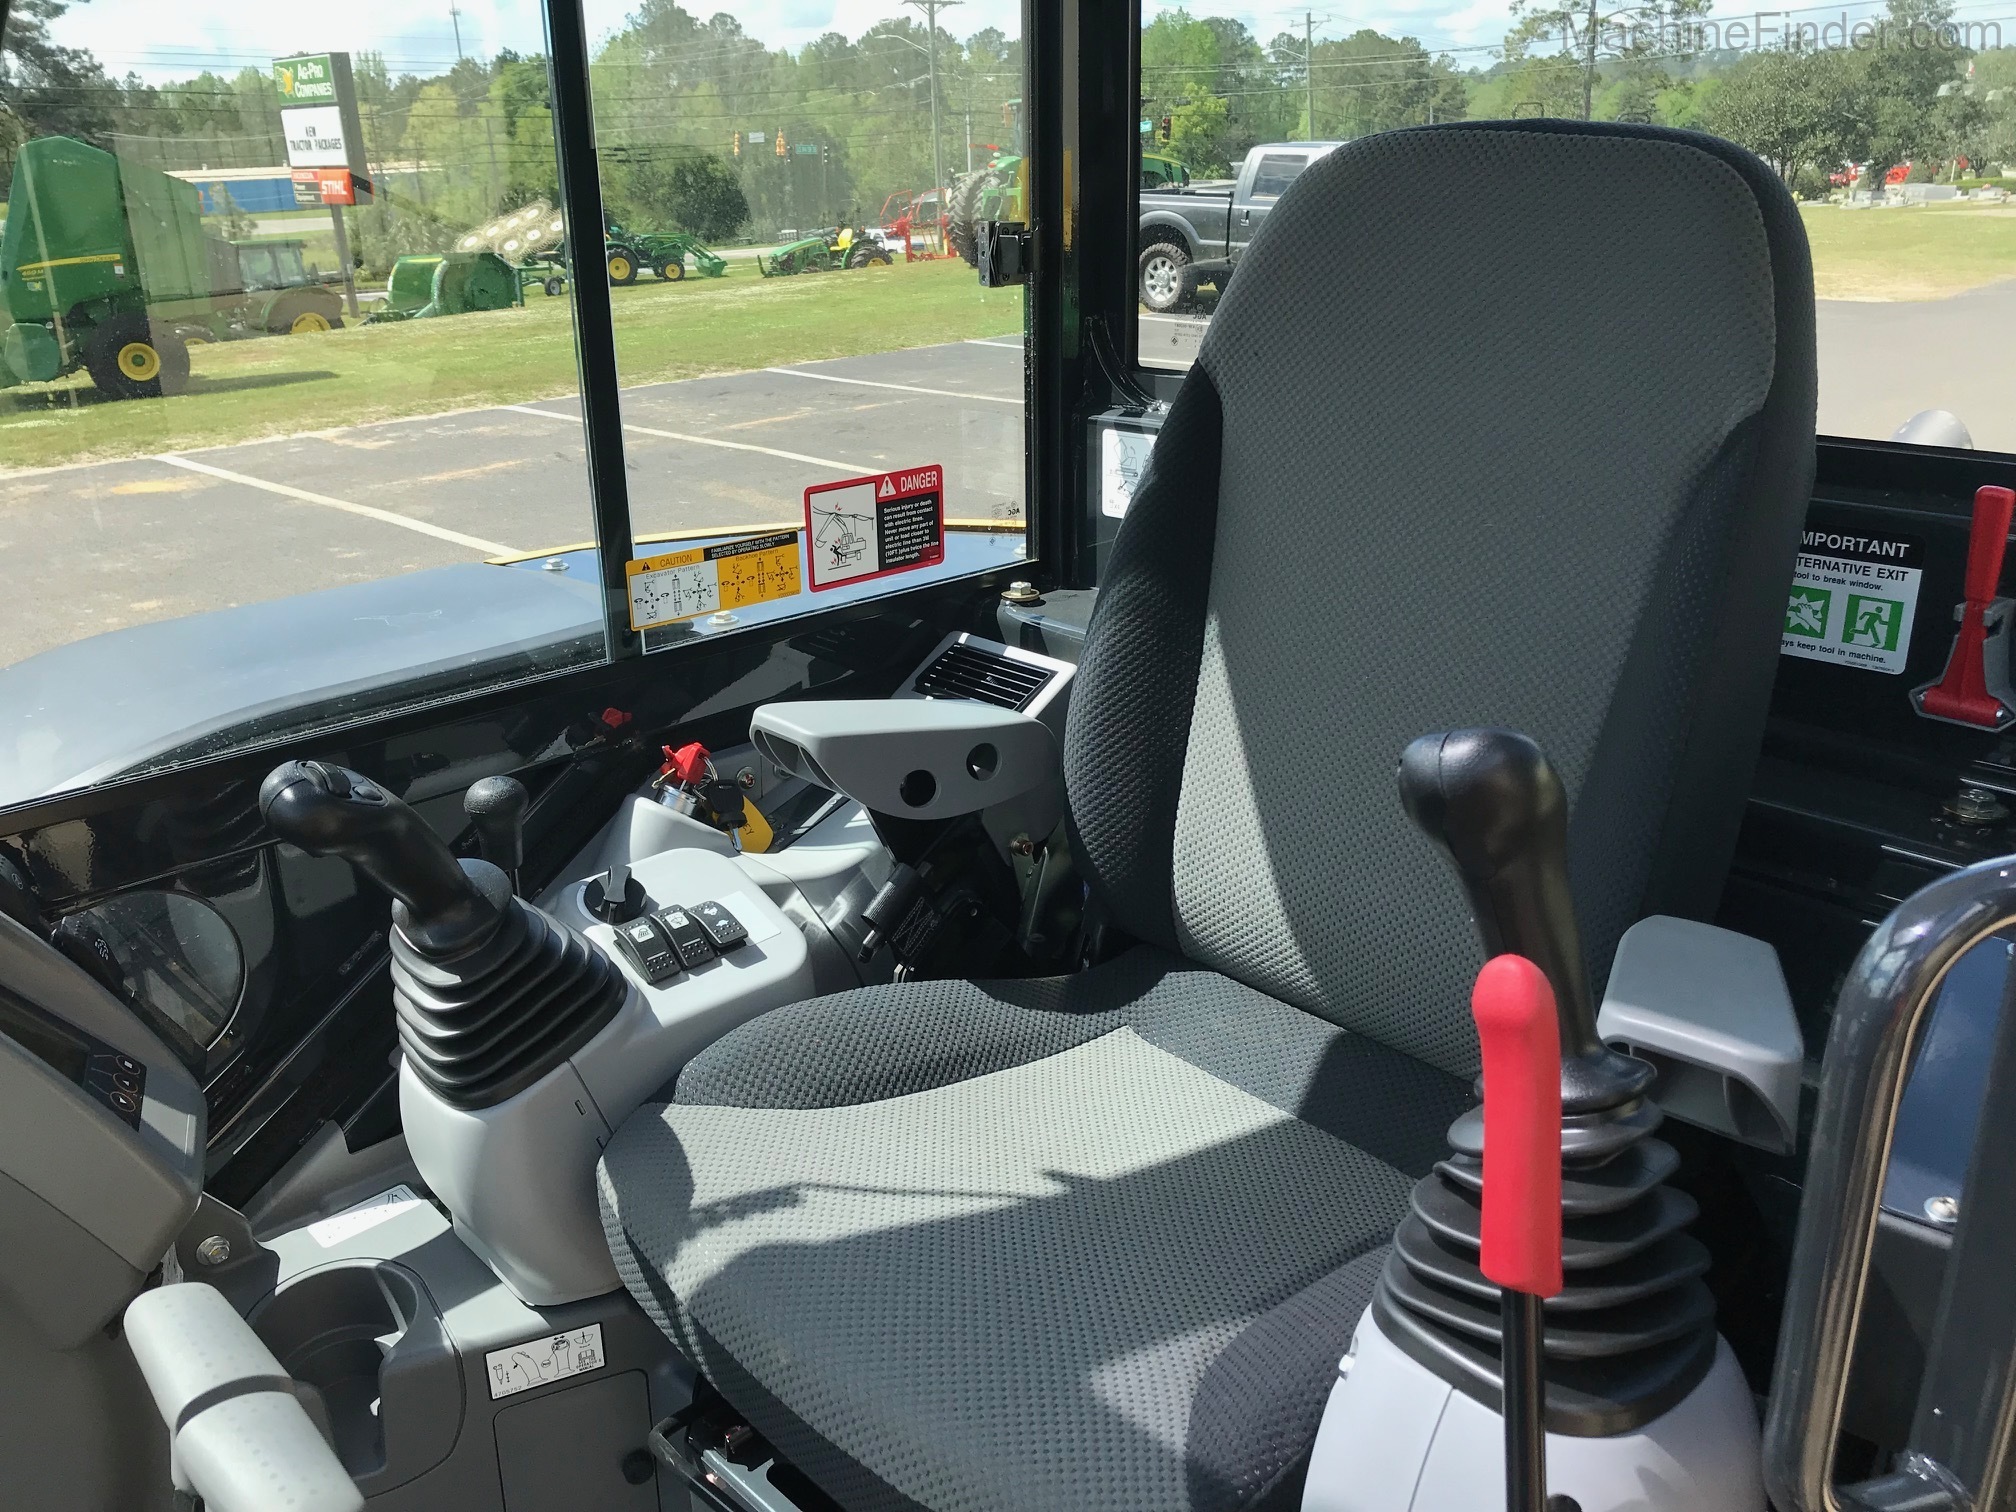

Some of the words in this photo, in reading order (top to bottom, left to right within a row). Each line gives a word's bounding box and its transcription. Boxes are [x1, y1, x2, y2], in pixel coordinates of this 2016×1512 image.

[290, 139, 312, 151] TRACTOR
[314, 138, 342, 150] PACKAGES
[321, 180, 348, 195] STIHL
[900, 470, 938, 492] DANGER
[884, 505, 900, 513] Serious
[893, 511, 905, 519] result
[917, 506, 933, 514] contact
[895, 518, 911, 526] electric
[920, 521, 928, 529] part
[885, 541, 902, 549] electric
[1800, 530, 1910, 558] MPORTANT
[660, 553, 693, 568] CAUTION
[736, 552, 758, 562] Backhoe
[759, 549, 778, 557] Pattern
[886, 555, 905, 564] insulator
[905, 551, 920, 559] length.
[645, 568, 676, 580] Excavator
[678, 564, 700, 573] Pattern
[1796, 556, 1872, 577] TERNATIVE
[1877, 567, 1909, 582] EXIT
[1812, 573, 1820, 581] to
[1823, 575, 1846, 586] break
[1849, 579, 1883, 591] window.
[1797, 640, 1816, 652] keep
[1819, 645, 1835, 654] tool
[1838, 648, 1846, 656] in
[1848, 651, 1886, 664] machine.
